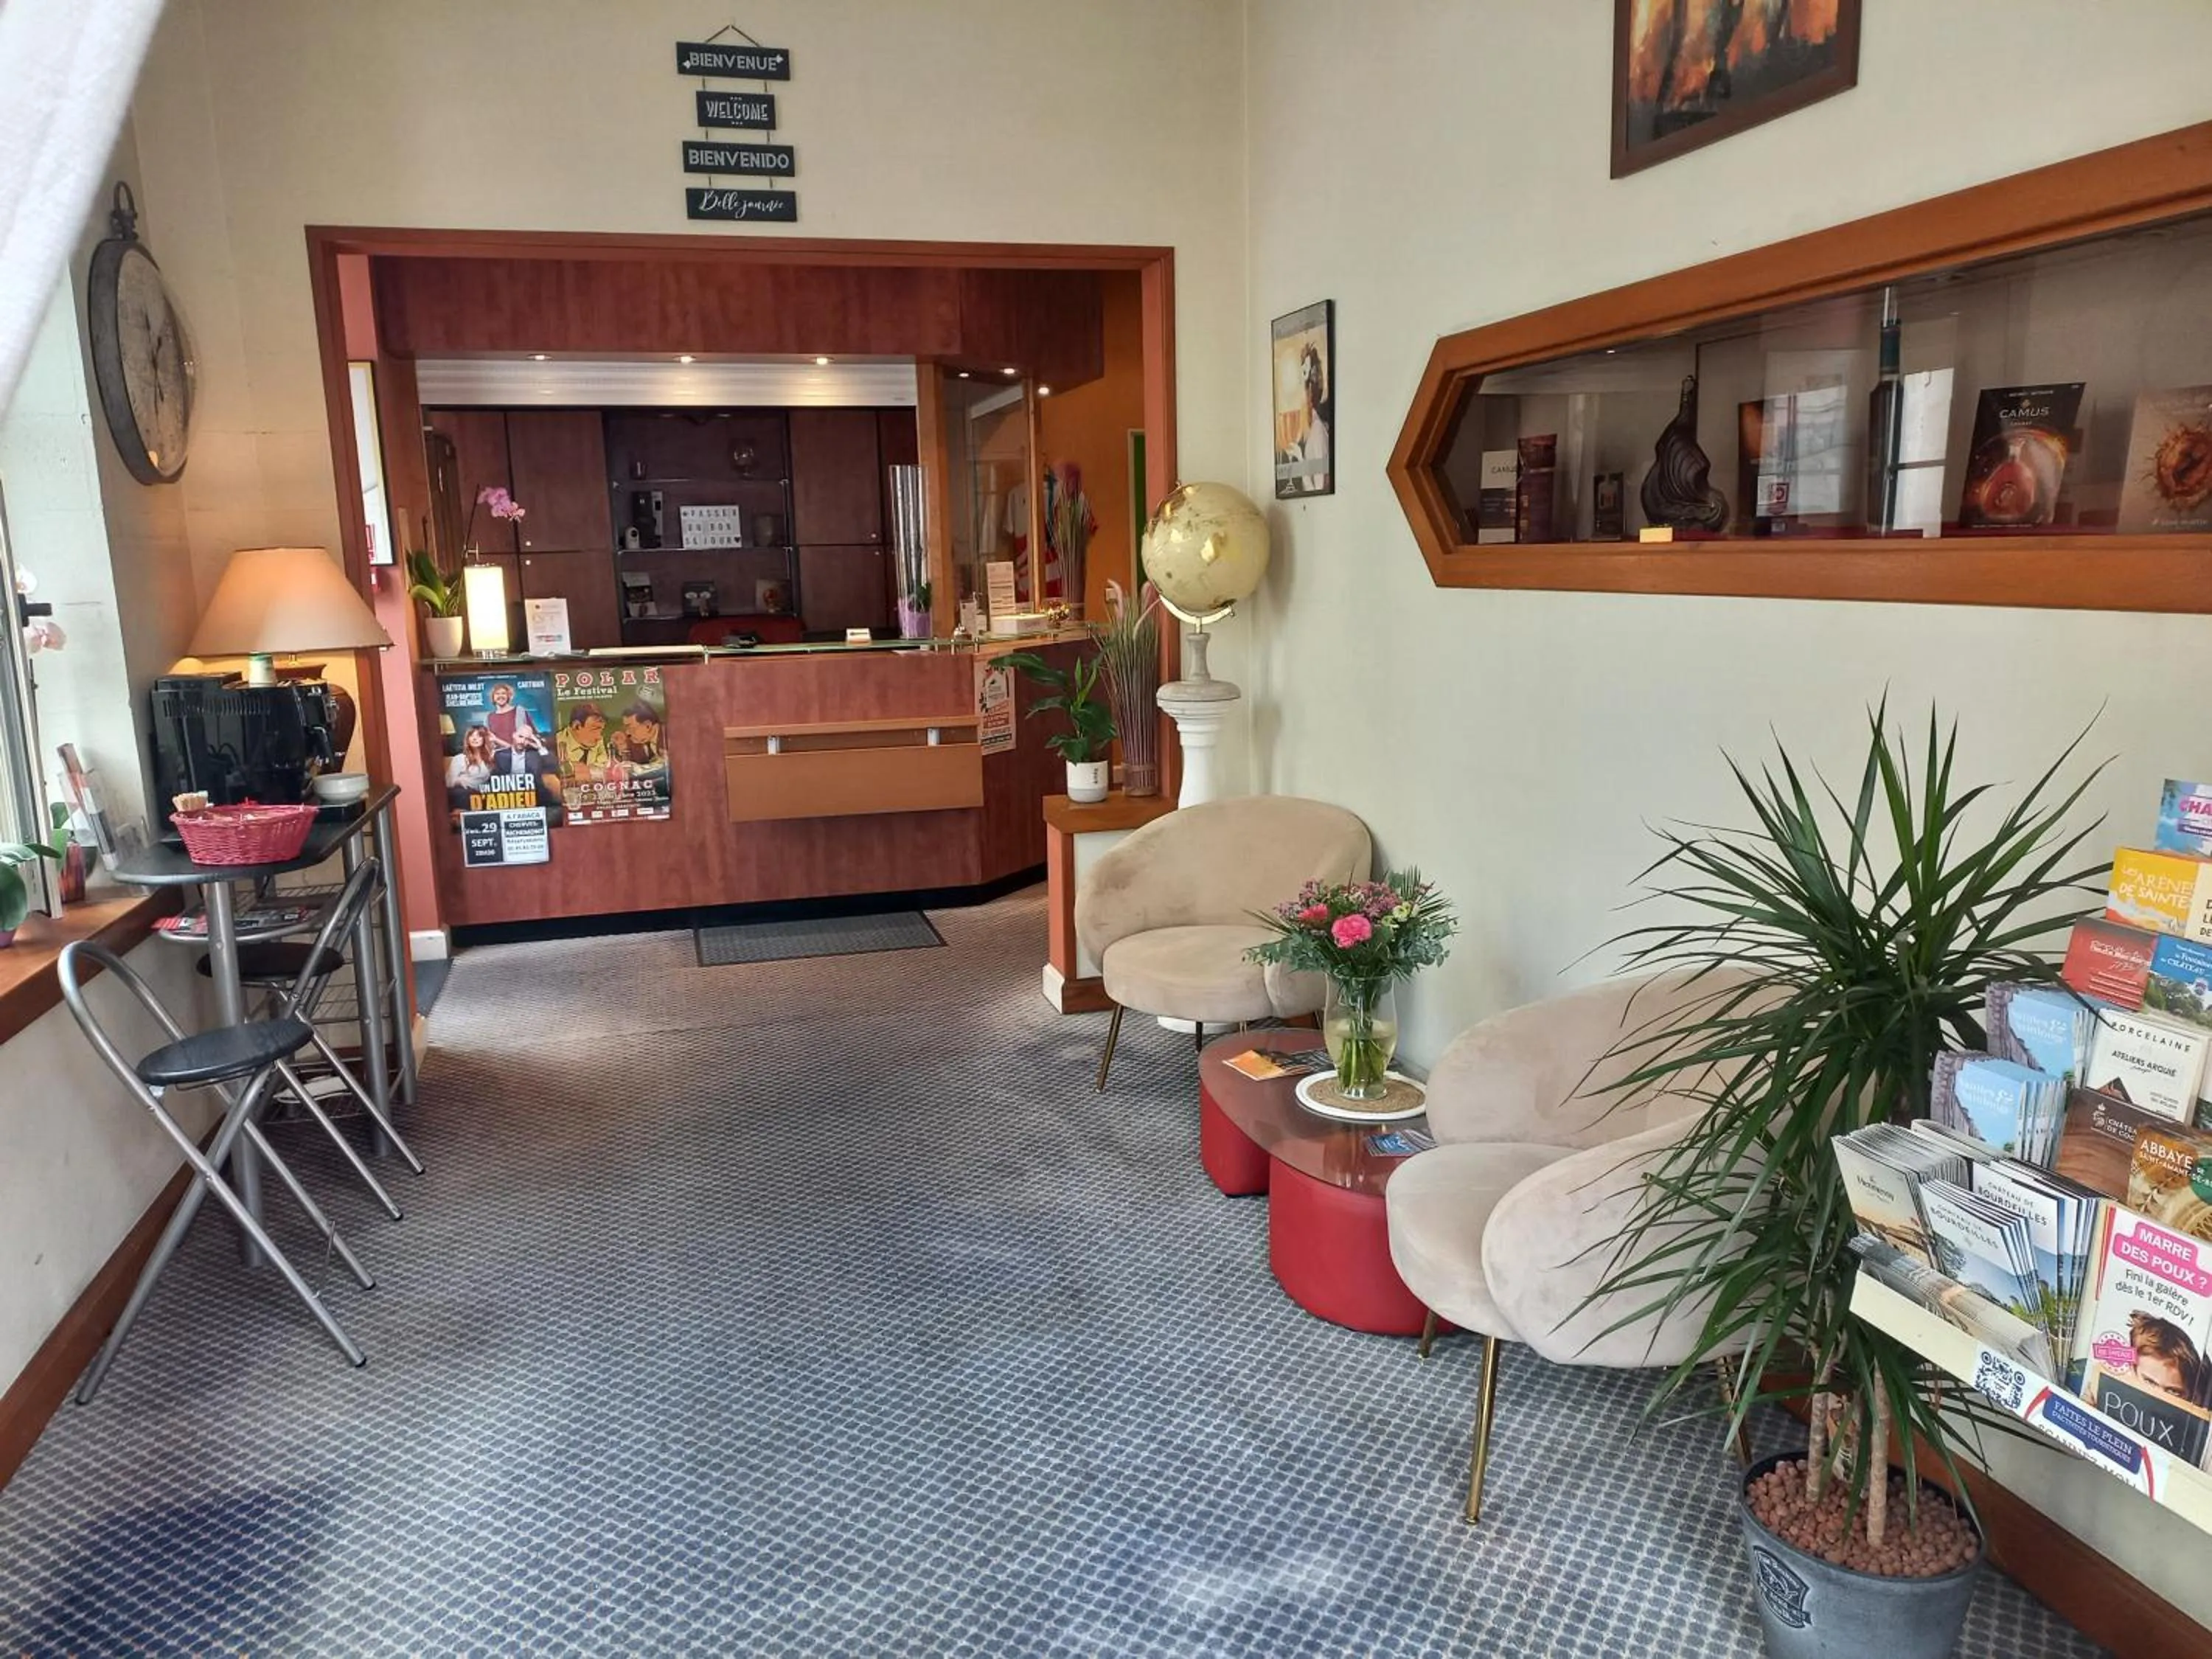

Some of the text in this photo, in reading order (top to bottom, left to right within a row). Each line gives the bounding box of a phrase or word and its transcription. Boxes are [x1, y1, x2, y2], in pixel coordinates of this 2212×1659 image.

[689, 51, 778, 72] BIENVENUE
[706, 100, 769, 122] WELCOME
[687, 148, 790, 169] BIENVENIDO
[1999, 406, 2051, 419] CAMUS
[555, 667, 660, 688] POLAR
[557, 686, 618, 697] Le Festival
[580, 779, 653, 793] COGNAC
[470, 791, 537, 810] D'ADIEU
[481, 821, 498, 833] 29
[2111, 1022, 2191, 1053] PORCELAINE
[2140, 1139, 2194, 1170] ABBAYE
[2139, 1228, 2193, 1262] MARRE
[2121, 1242, 2149, 1263] DES
[2151, 1255, 2197, 1286] POUX
[2126, 1268, 2189, 1306] Fini la galère
[2115, 1281, 2133, 1294] dès
[2135, 1286, 2145, 1298] le
[2146, 1291, 2164, 1307] 1er
[2165, 1301, 2189, 1321] RDV
[2053, 1400, 2133, 1455] FAITES LE PLEIN
[2104, 1391, 2174, 1447] POUX
